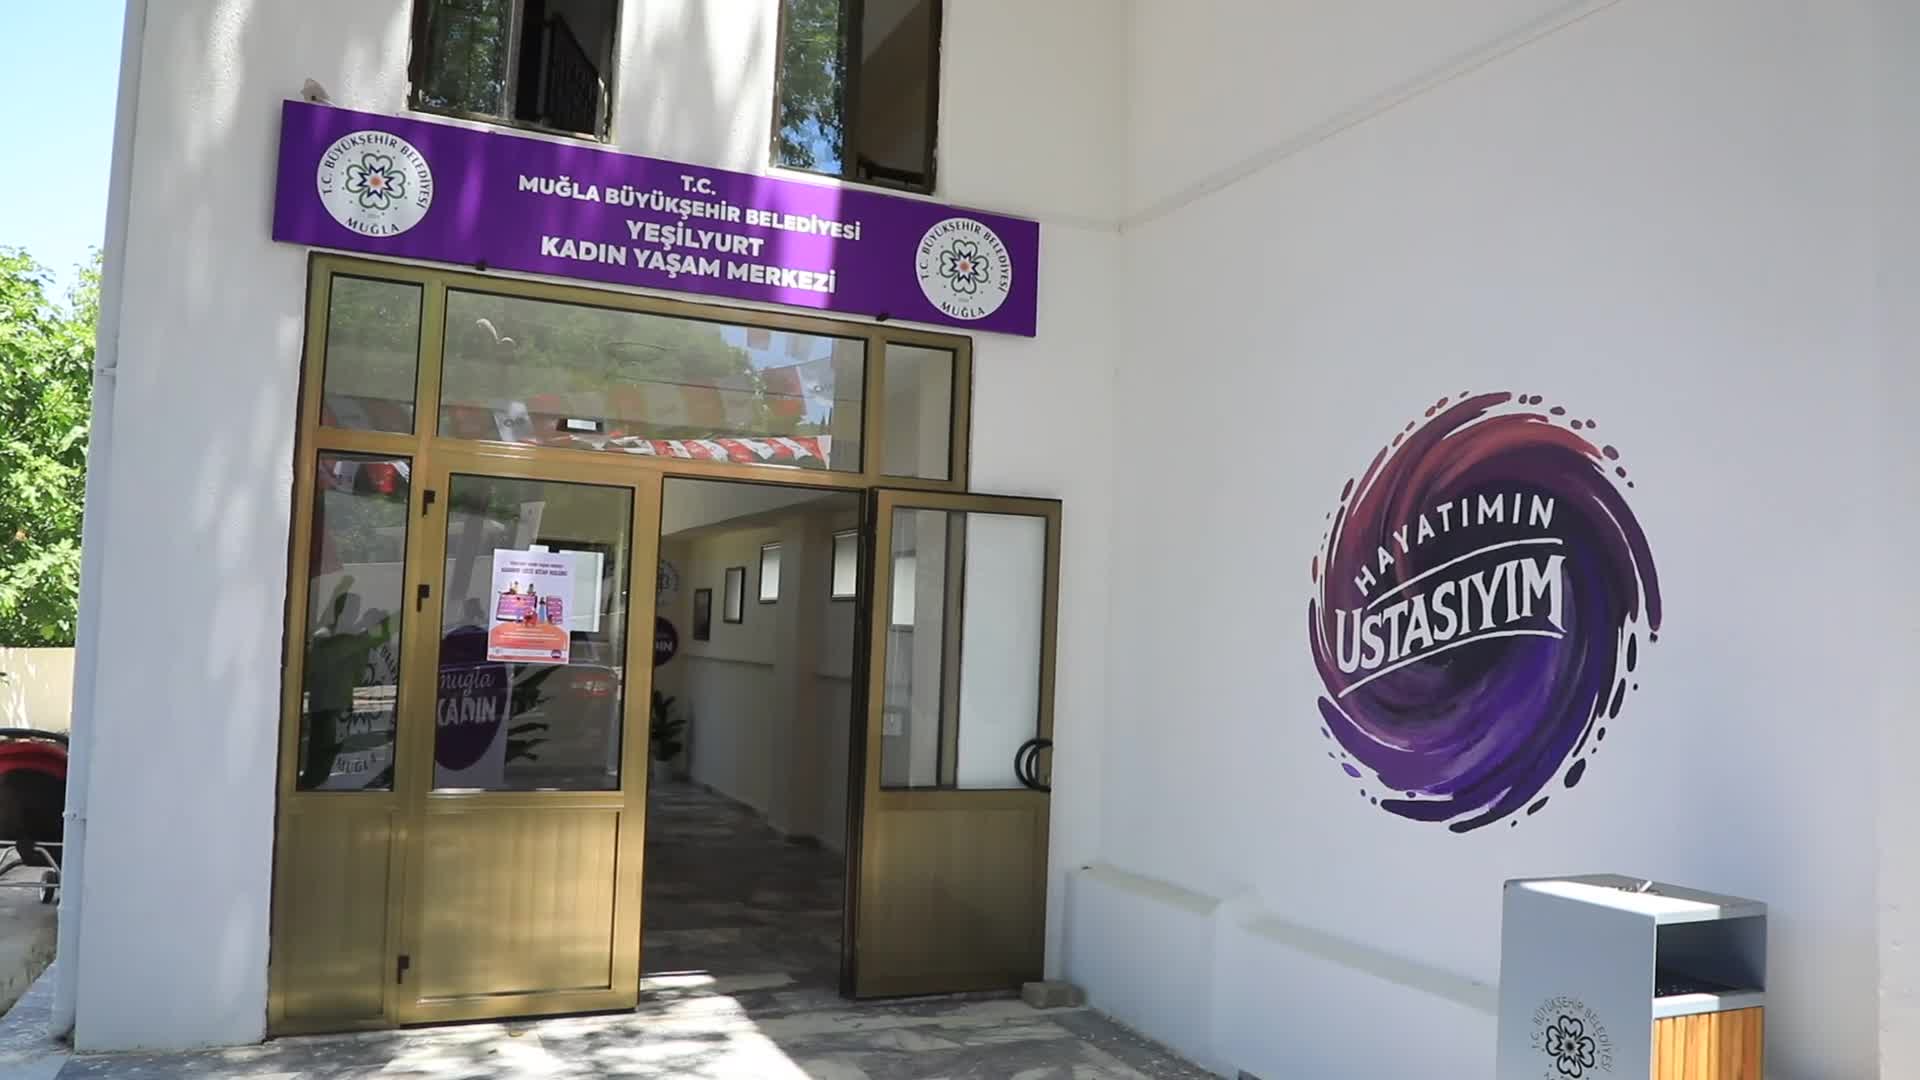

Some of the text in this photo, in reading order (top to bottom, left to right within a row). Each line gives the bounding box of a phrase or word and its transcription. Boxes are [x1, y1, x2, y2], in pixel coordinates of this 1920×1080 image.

[324, 133, 398, 169] BÜYÜKŞEHİR
[400, 145, 433, 209] BELEDİYESİ
[680, 175, 716, 196] T.C.
[345, 216, 400, 235] MUĞLA
[518, 174, 861, 240] MUĞLA BÜYÜKŞEHİR BELEDİYESİ
[540, 235, 836, 294] KADIN YAŞAM MERKEZİ
[626, 219, 764, 257] YEŞİLYURT
[941, 301, 985, 318] MUĞLA
[1354, 493, 1555, 597] HAYATIMIN
[1335, 555, 1567, 674] USTASIYIM
